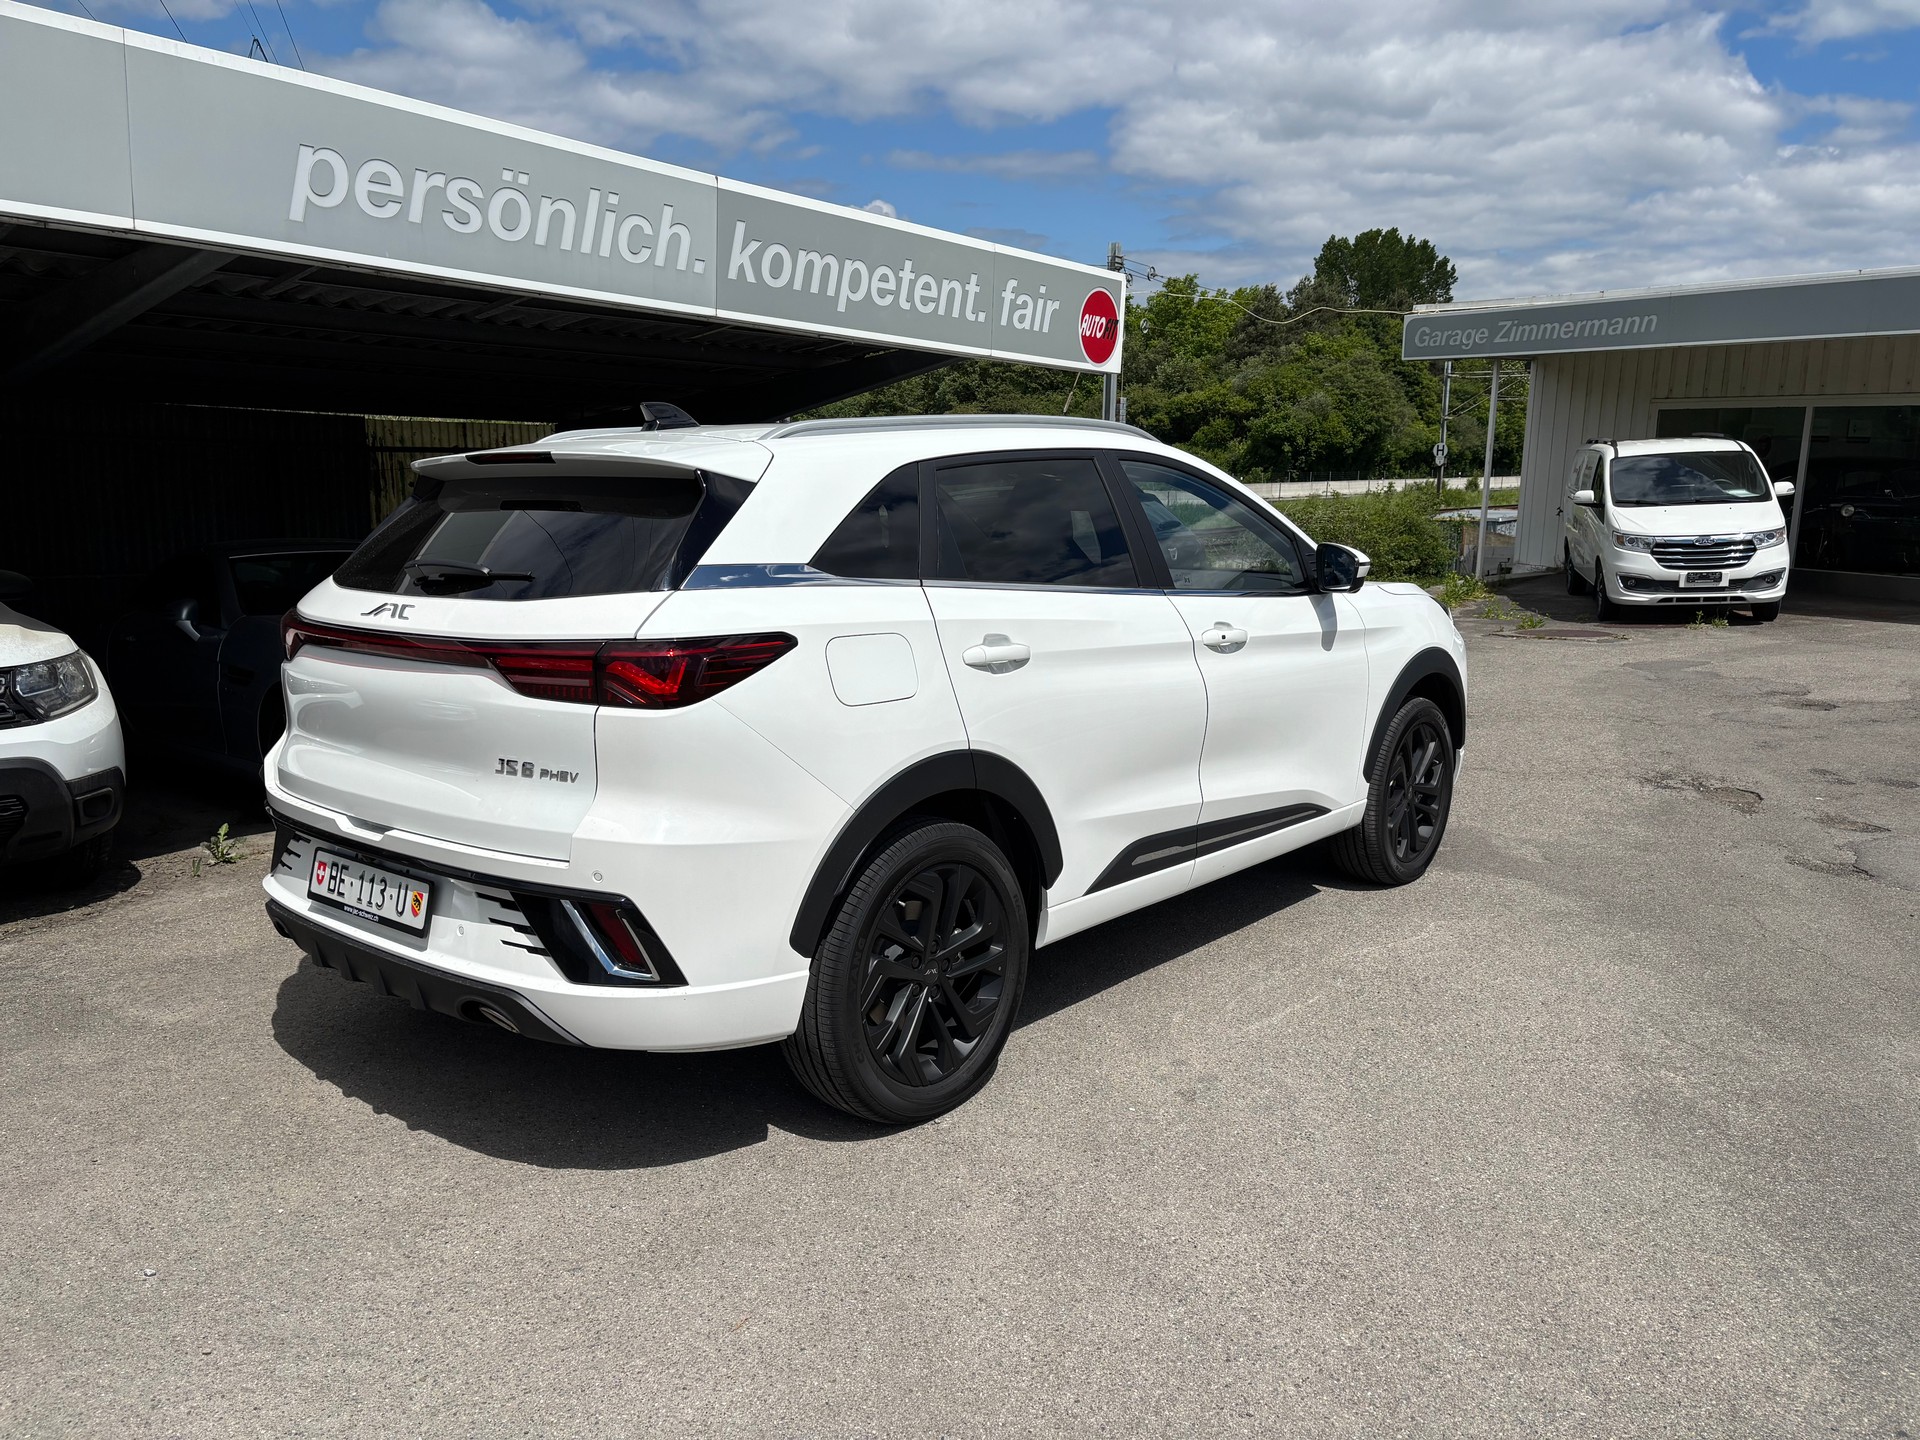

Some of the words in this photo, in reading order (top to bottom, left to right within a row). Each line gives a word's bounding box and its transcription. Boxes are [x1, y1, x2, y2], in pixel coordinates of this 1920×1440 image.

[289, 143, 706, 274] persönlich.
[728, 219, 986, 323] kompetent.
[1000, 278, 1060, 333] fair
[1414, 326, 1489, 349] Garage
[1493, 314, 1658, 343] Zimmermann
[1437, 445, 1445, 456] H
[540, 768, 579, 784] PHEV
